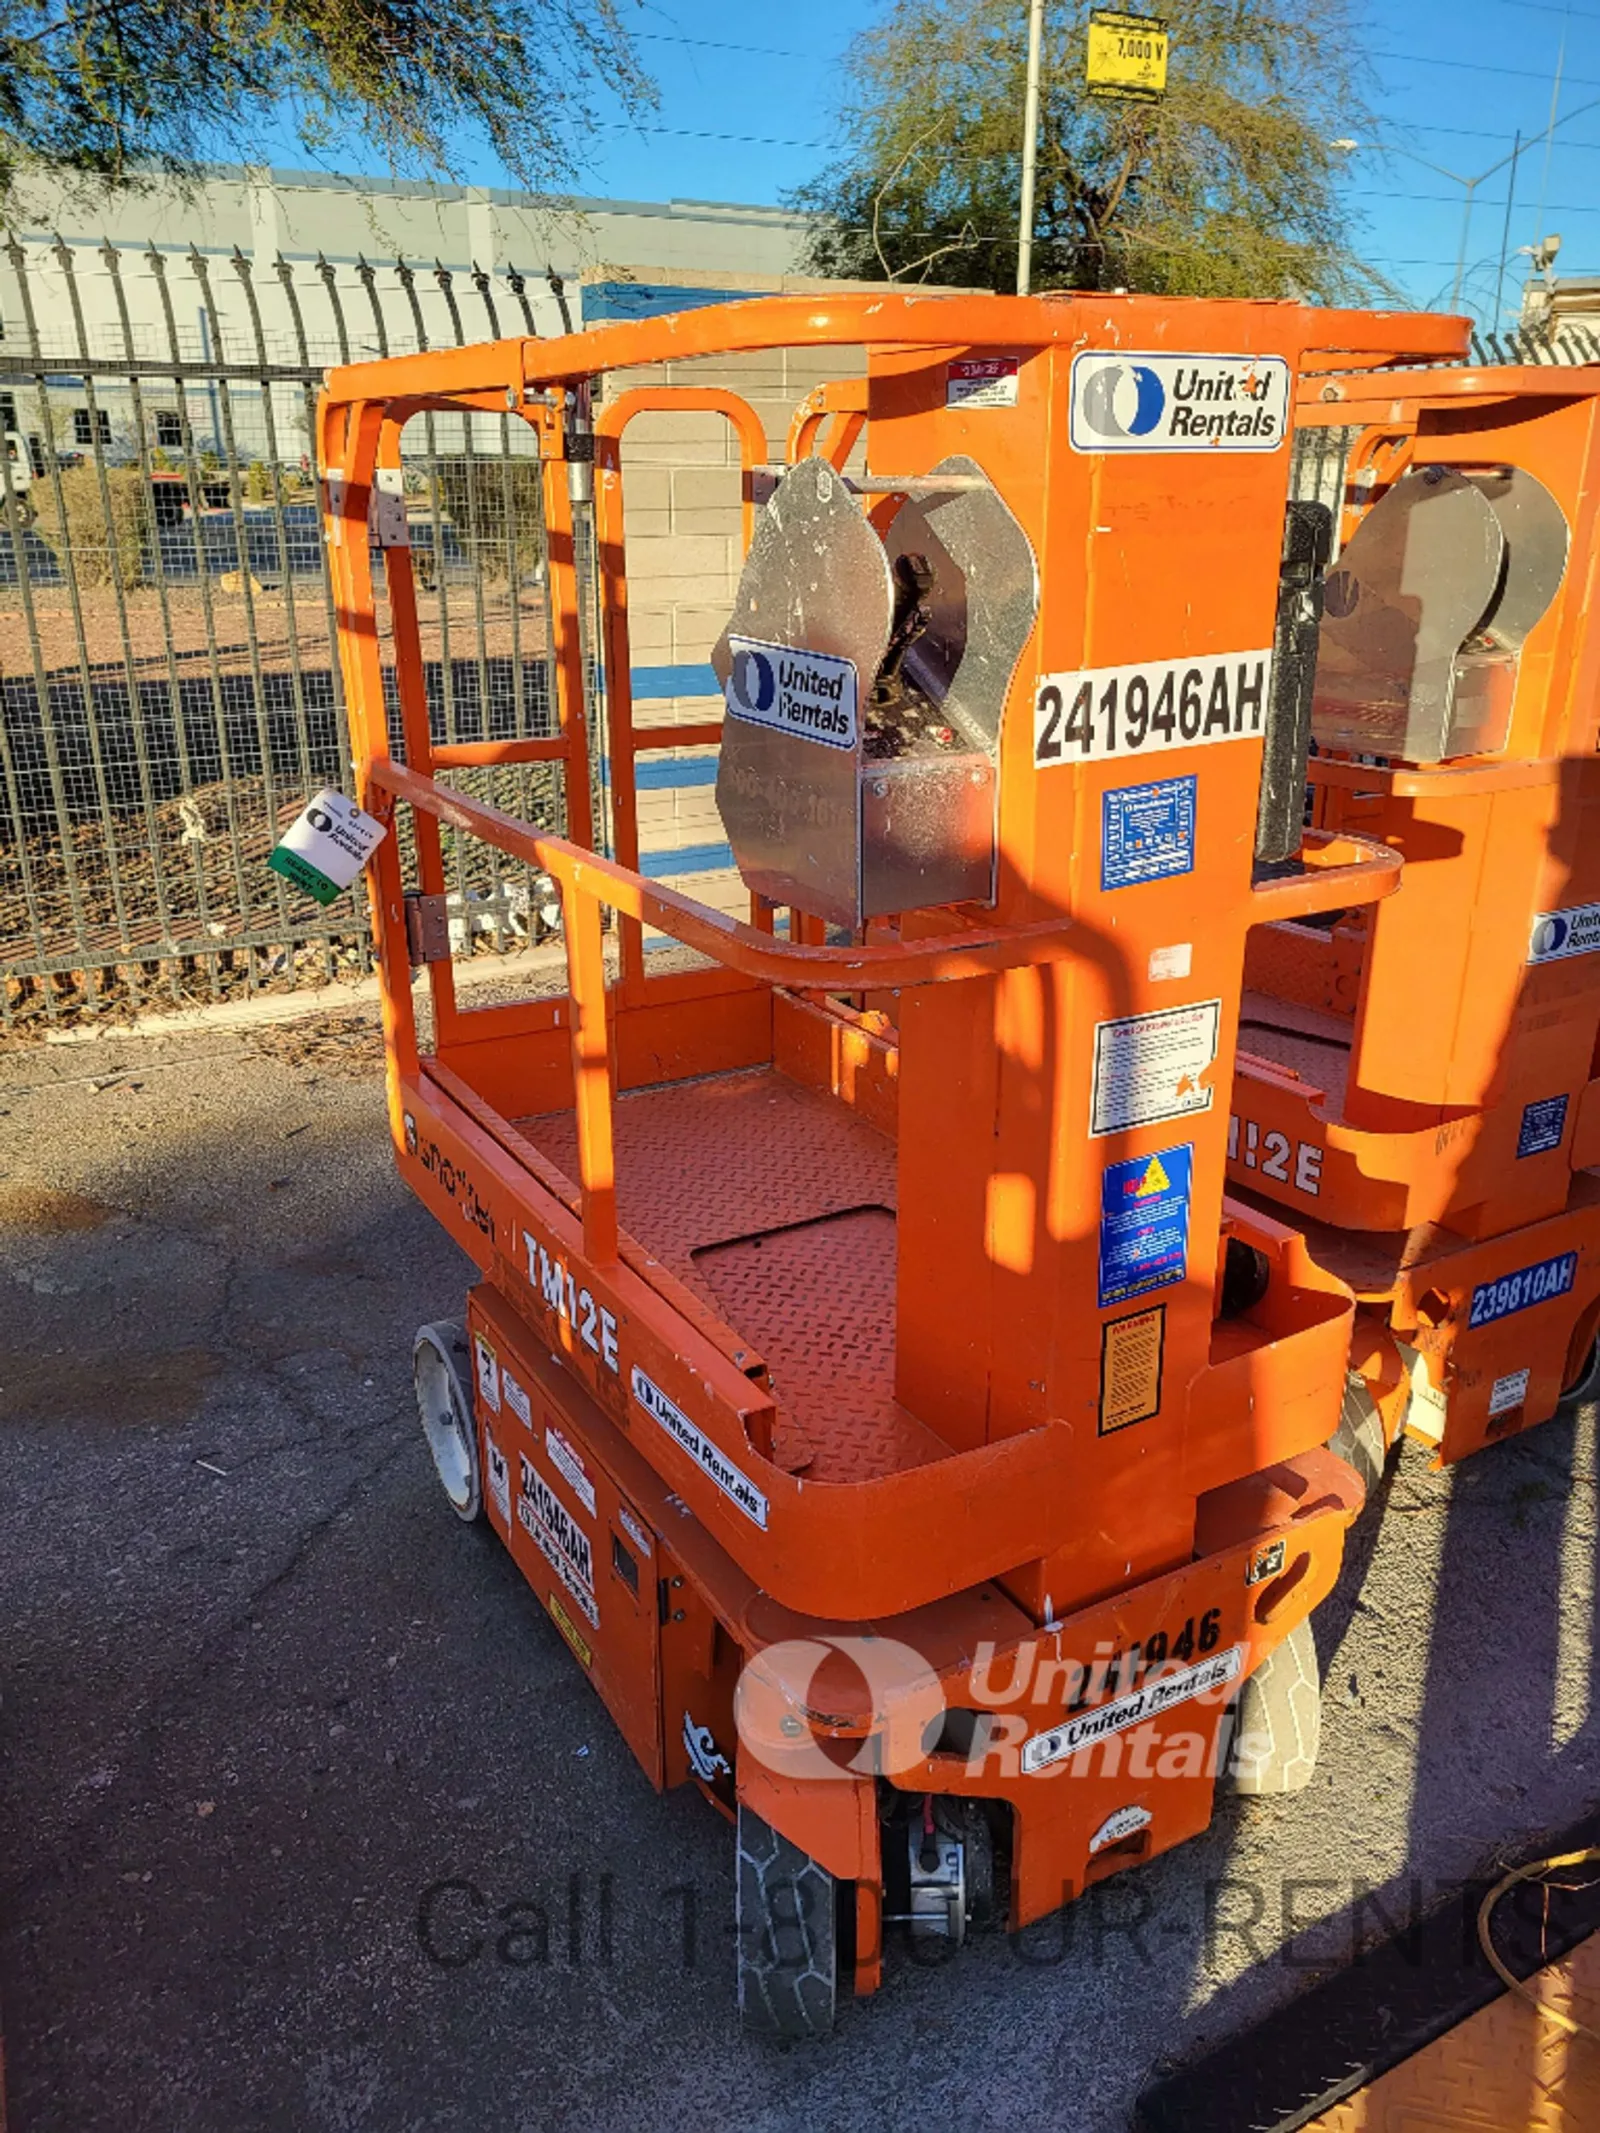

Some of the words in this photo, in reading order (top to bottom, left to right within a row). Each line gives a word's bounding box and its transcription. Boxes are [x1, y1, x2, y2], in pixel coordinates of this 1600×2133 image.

[1117, 37, 1152, 59] 7,000
[1168, 405, 1276, 438] Rentals
[778, 659, 846, 701] United
[778, 691, 849, 735] Rentals
[1036, 661, 1265, 761] 241946AH
[522, 1228, 619, 1375] TM12E
[1470, 1254, 1576, 1324] 239810AH
[656, 1395, 700, 1455] United
[701, 1443, 758, 1513] Rentals
[1067, 1695, 1145, 1746] United
[1147, 1660, 1229, 1709] Rentals
